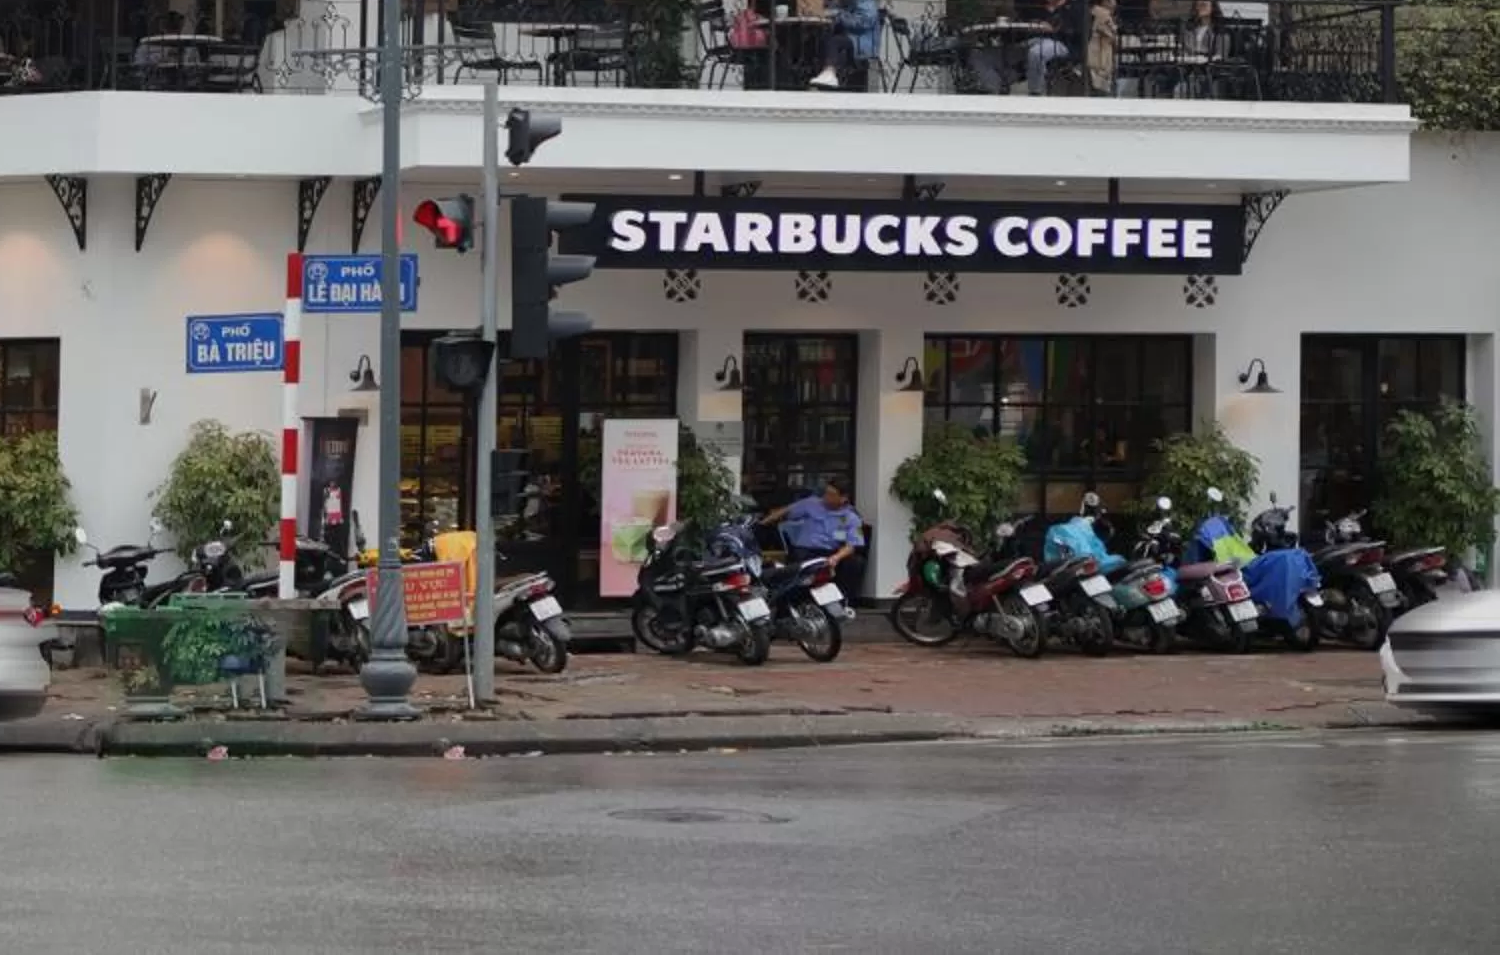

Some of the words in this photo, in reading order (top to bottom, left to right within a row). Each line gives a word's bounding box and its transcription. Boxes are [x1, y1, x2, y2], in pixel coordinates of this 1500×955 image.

[610, 210, 978, 257] STARBUCKS
[992, 216, 1214, 258] COFFEE
[341, 261, 375, 278] PHỐ
[360, 280, 405, 302] HÀ
[222, 323, 251, 337] PHỐ
[197, 339, 221, 363] BÀ
[226, 338, 275, 366] TRIỆU
